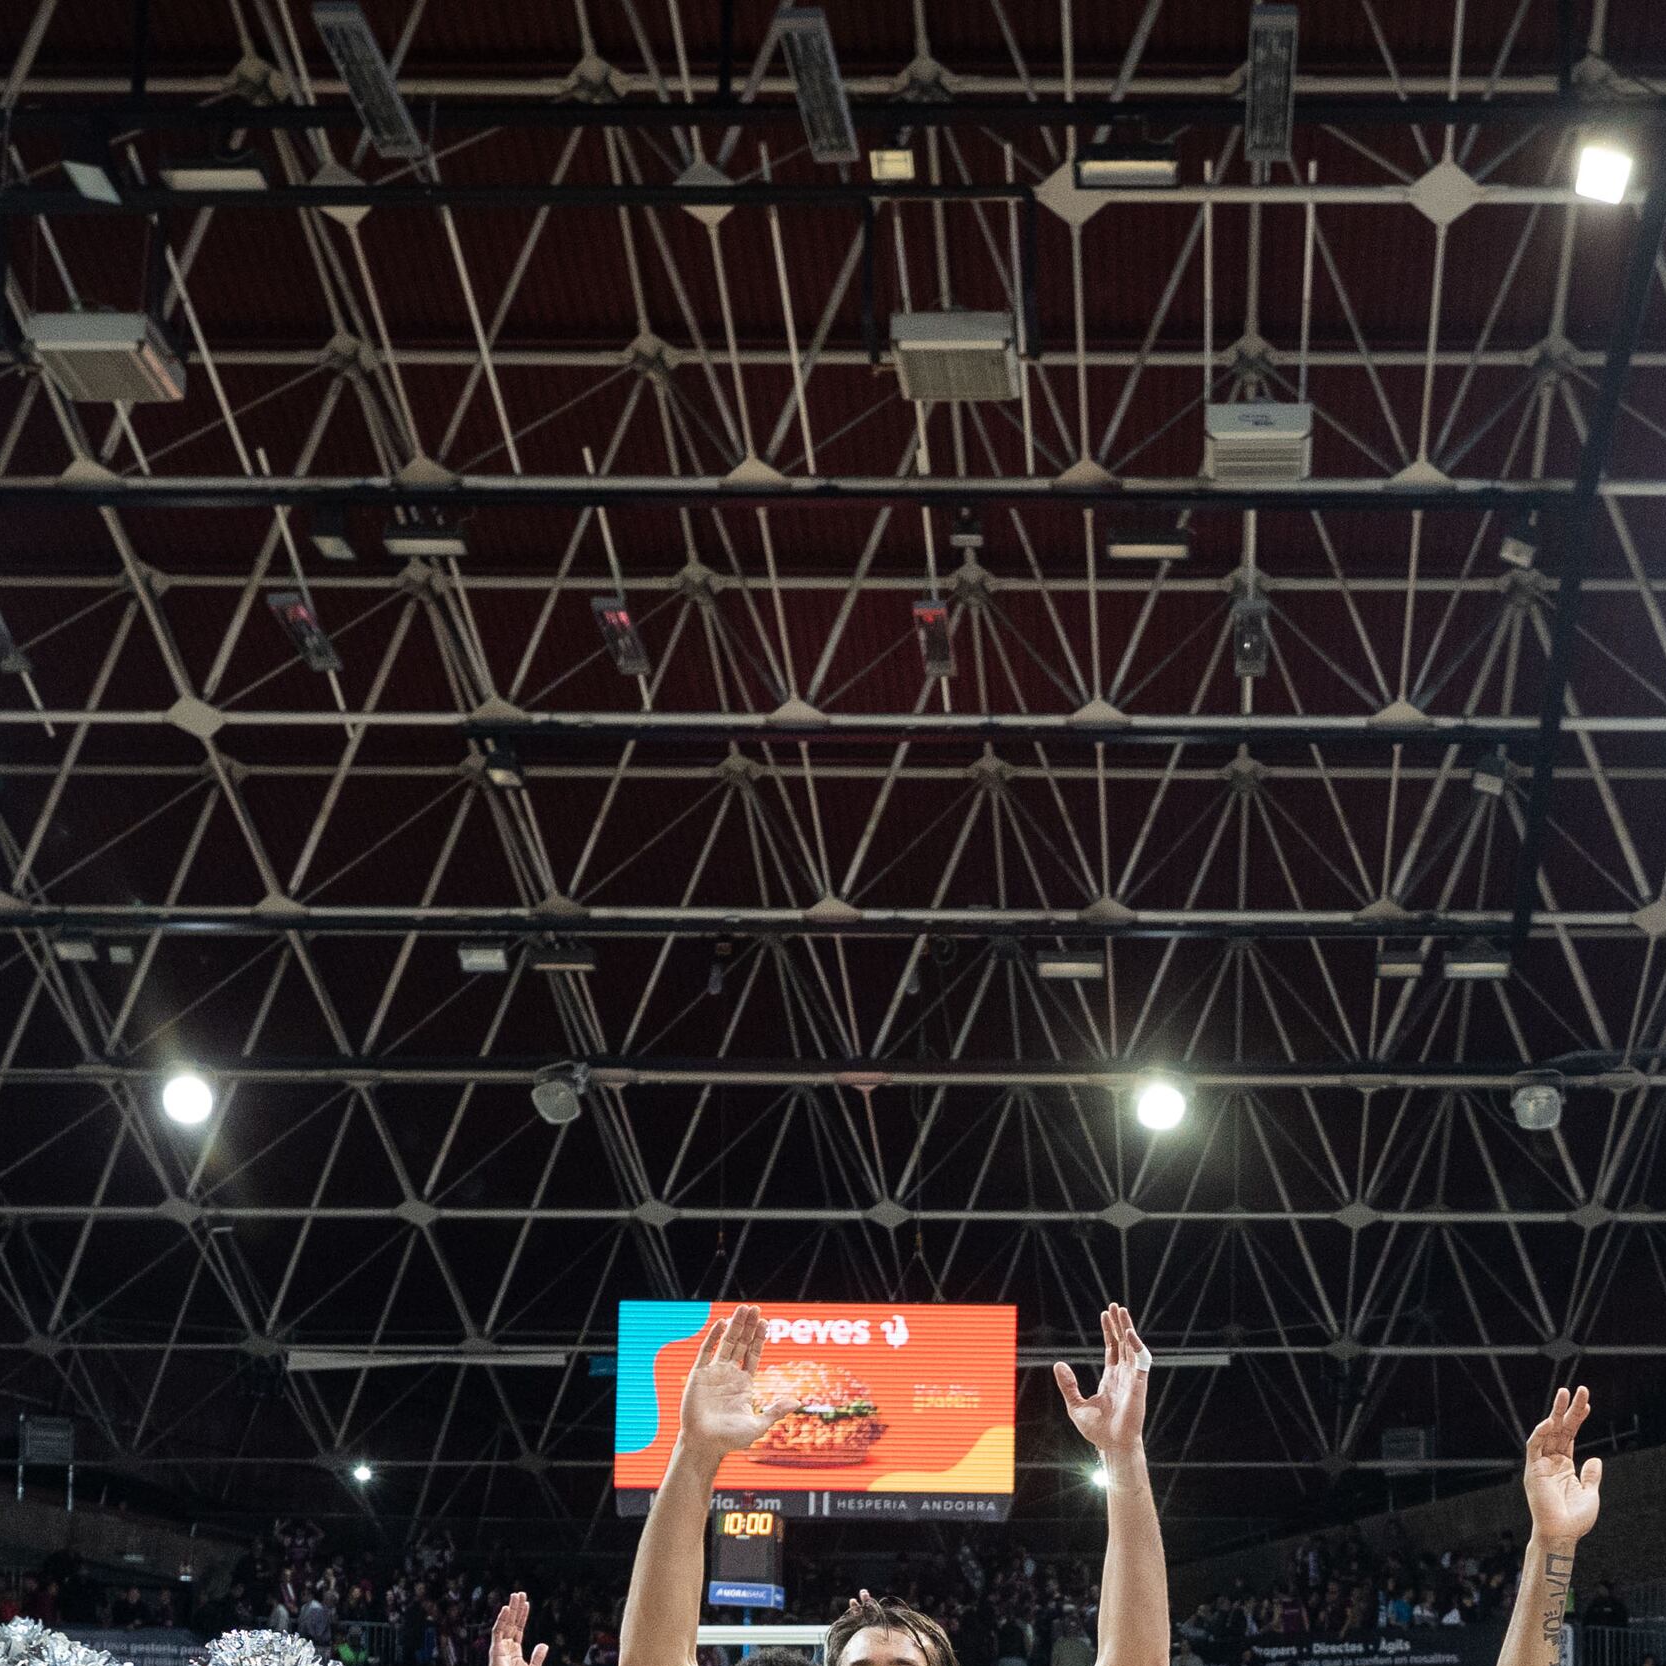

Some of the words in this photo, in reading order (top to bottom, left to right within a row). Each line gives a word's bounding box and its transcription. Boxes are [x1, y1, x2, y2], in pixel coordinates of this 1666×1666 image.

[837, 1499, 908, 1511] HESPERIA
[921, 1499, 996, 1512] ANDORRA
[724, 1512, 774, 1536] 10:00
